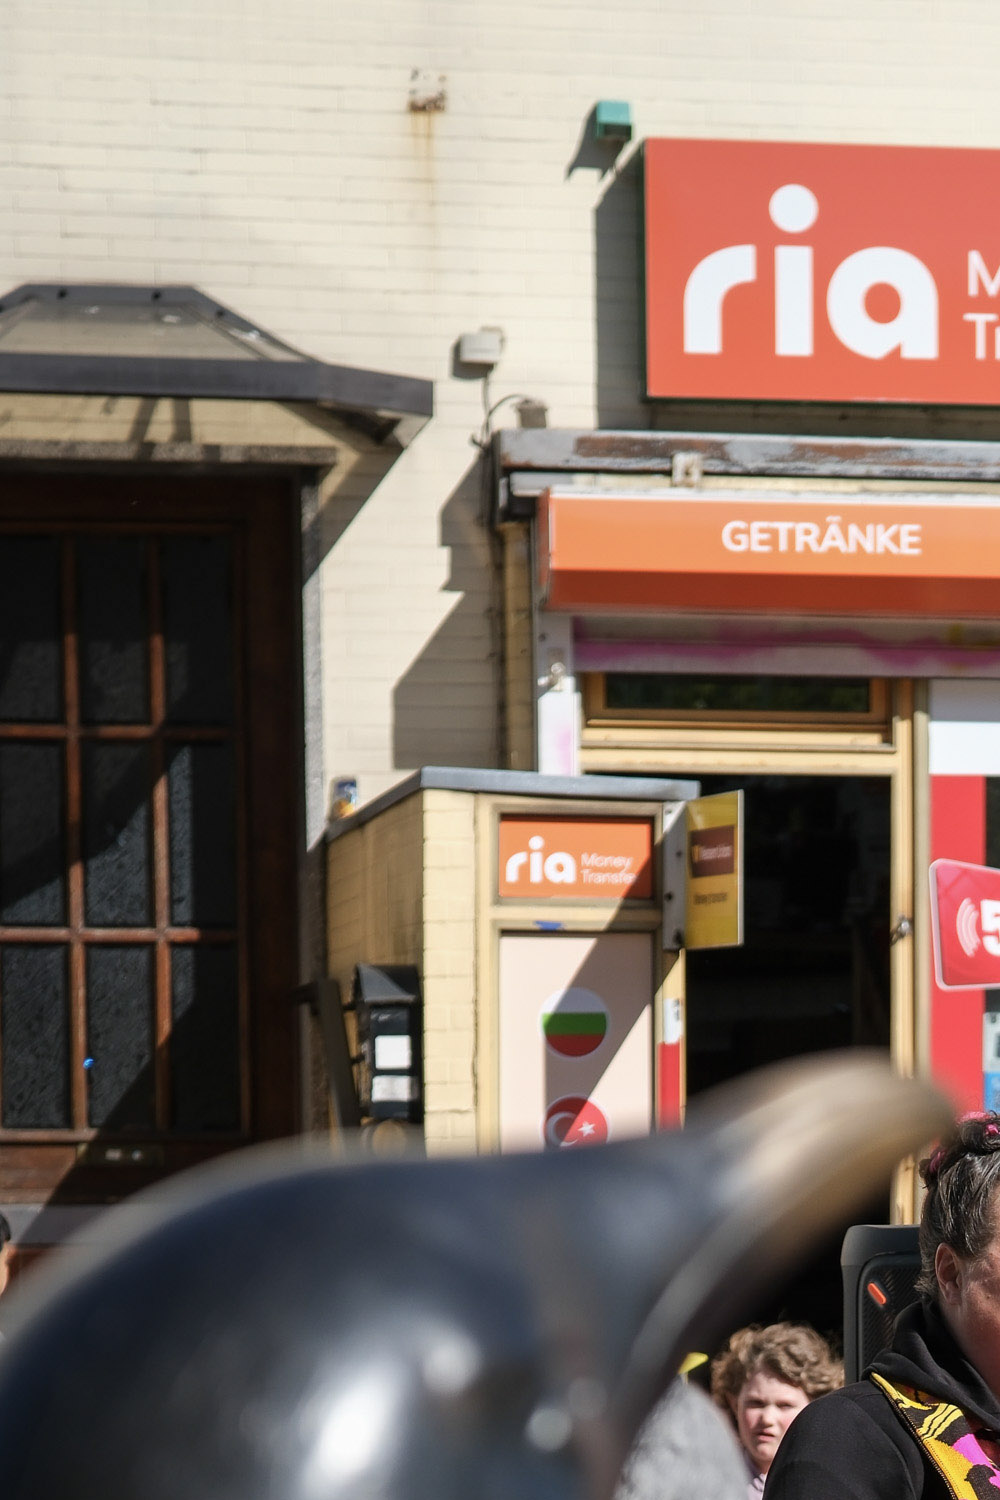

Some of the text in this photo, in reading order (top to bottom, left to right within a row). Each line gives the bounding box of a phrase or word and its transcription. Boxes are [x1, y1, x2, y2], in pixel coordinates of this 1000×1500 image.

[683, 183, 940, 360] ria
[721, 515, 922, 556] GETRÄNKE
[505, 835, 577, 884] ria
[580, 852, 634, 871] Money
